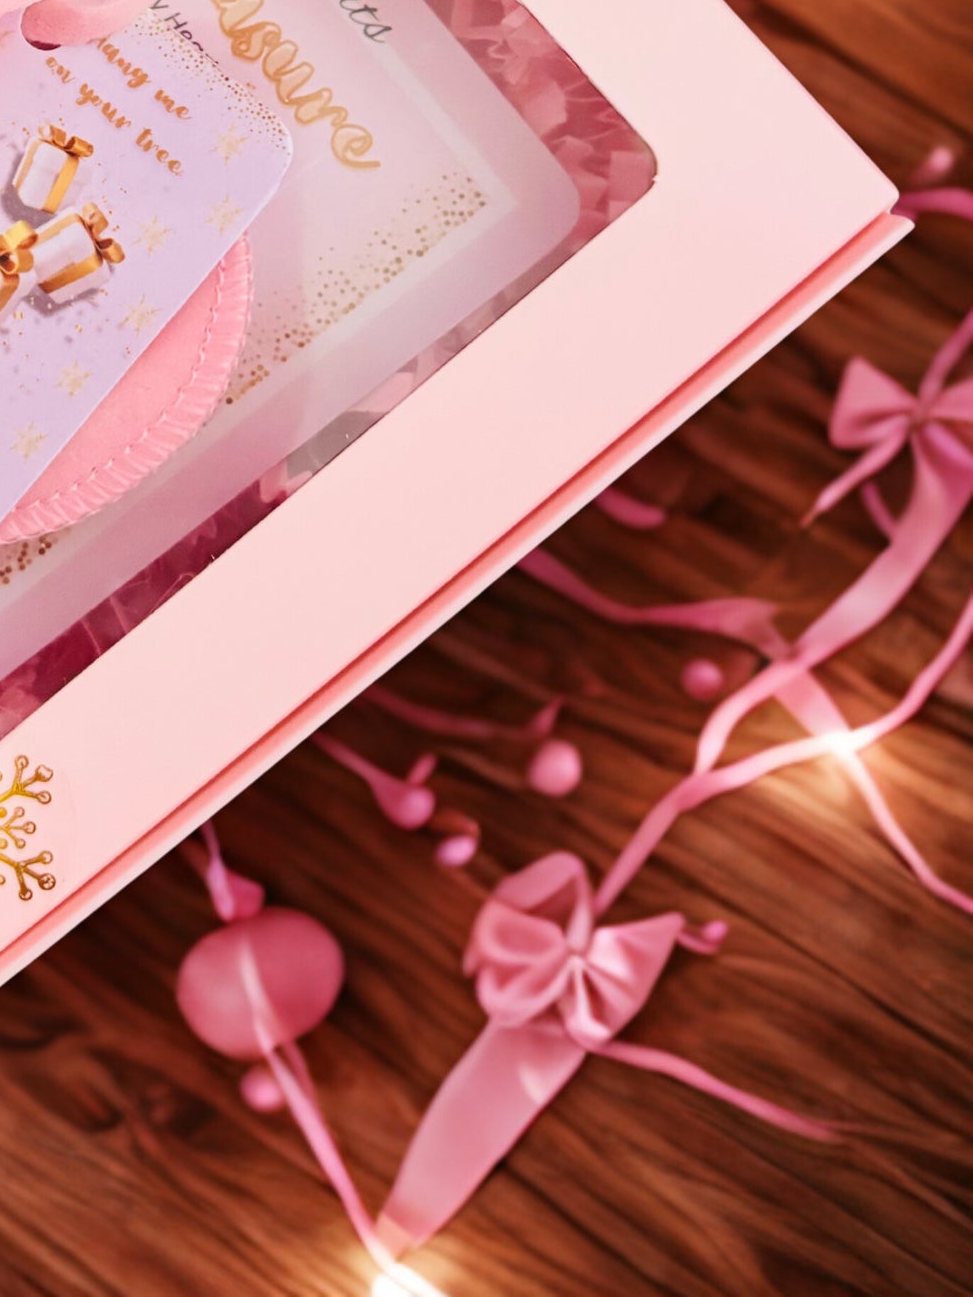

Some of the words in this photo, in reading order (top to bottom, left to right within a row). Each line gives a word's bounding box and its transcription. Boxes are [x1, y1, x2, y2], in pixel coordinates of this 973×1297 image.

[45, 56, 76, 84] on
[76, 82, 132, 129] your
[134, 127, 184, 177] tree
[154, 88, 193, 120] me
